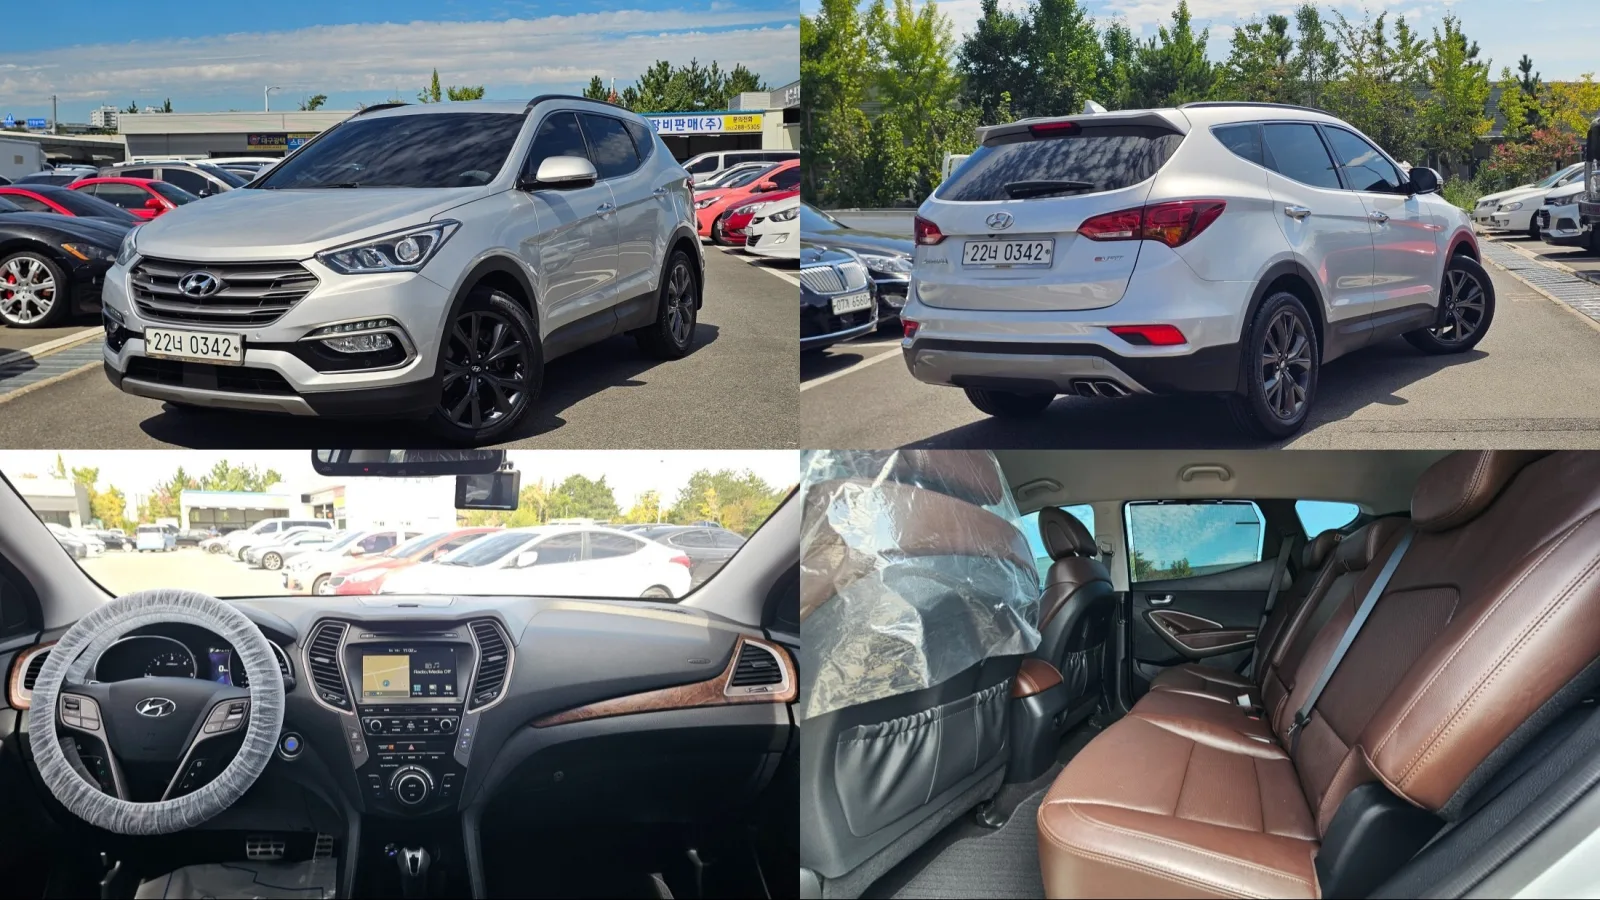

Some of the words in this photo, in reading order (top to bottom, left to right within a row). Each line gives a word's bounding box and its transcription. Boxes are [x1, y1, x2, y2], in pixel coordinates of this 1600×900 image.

[970, 244, 998, 261] 22너
[1004, 243, 1044, 261] 0342
[153, 332, 183, 352] 22너
[190, 335, 231, 357] 0342
